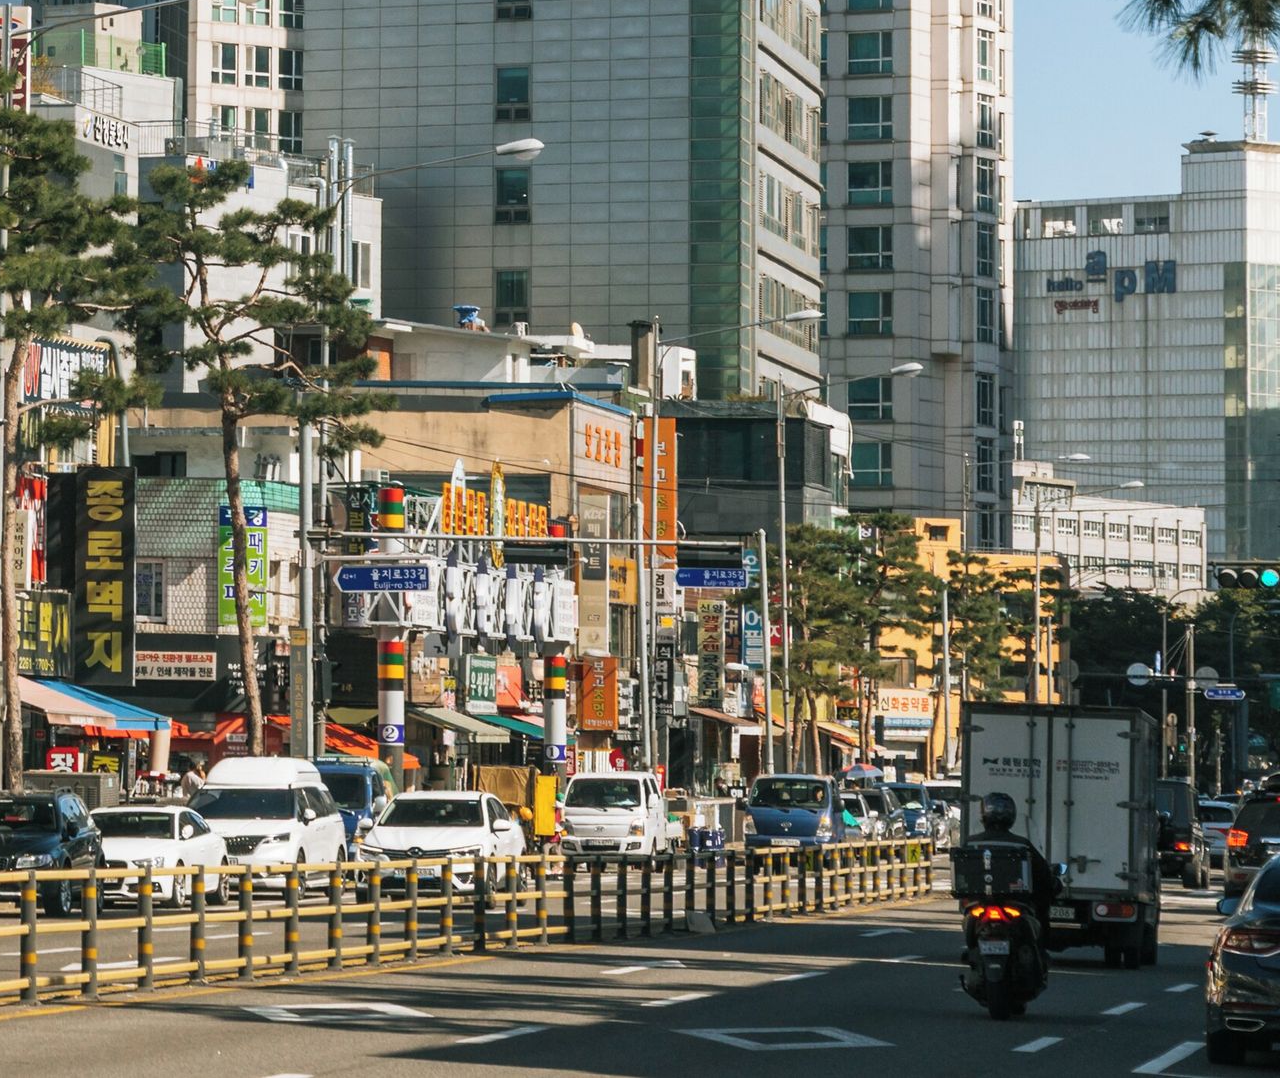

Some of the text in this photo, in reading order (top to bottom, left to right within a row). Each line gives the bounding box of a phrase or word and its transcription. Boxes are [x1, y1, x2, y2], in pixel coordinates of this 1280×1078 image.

[583, 510, 606, 520] KCC
[370, 568, 428, 580] 을지로33길
[374, 580, 428, 591] Eulji-ro 33-gil
